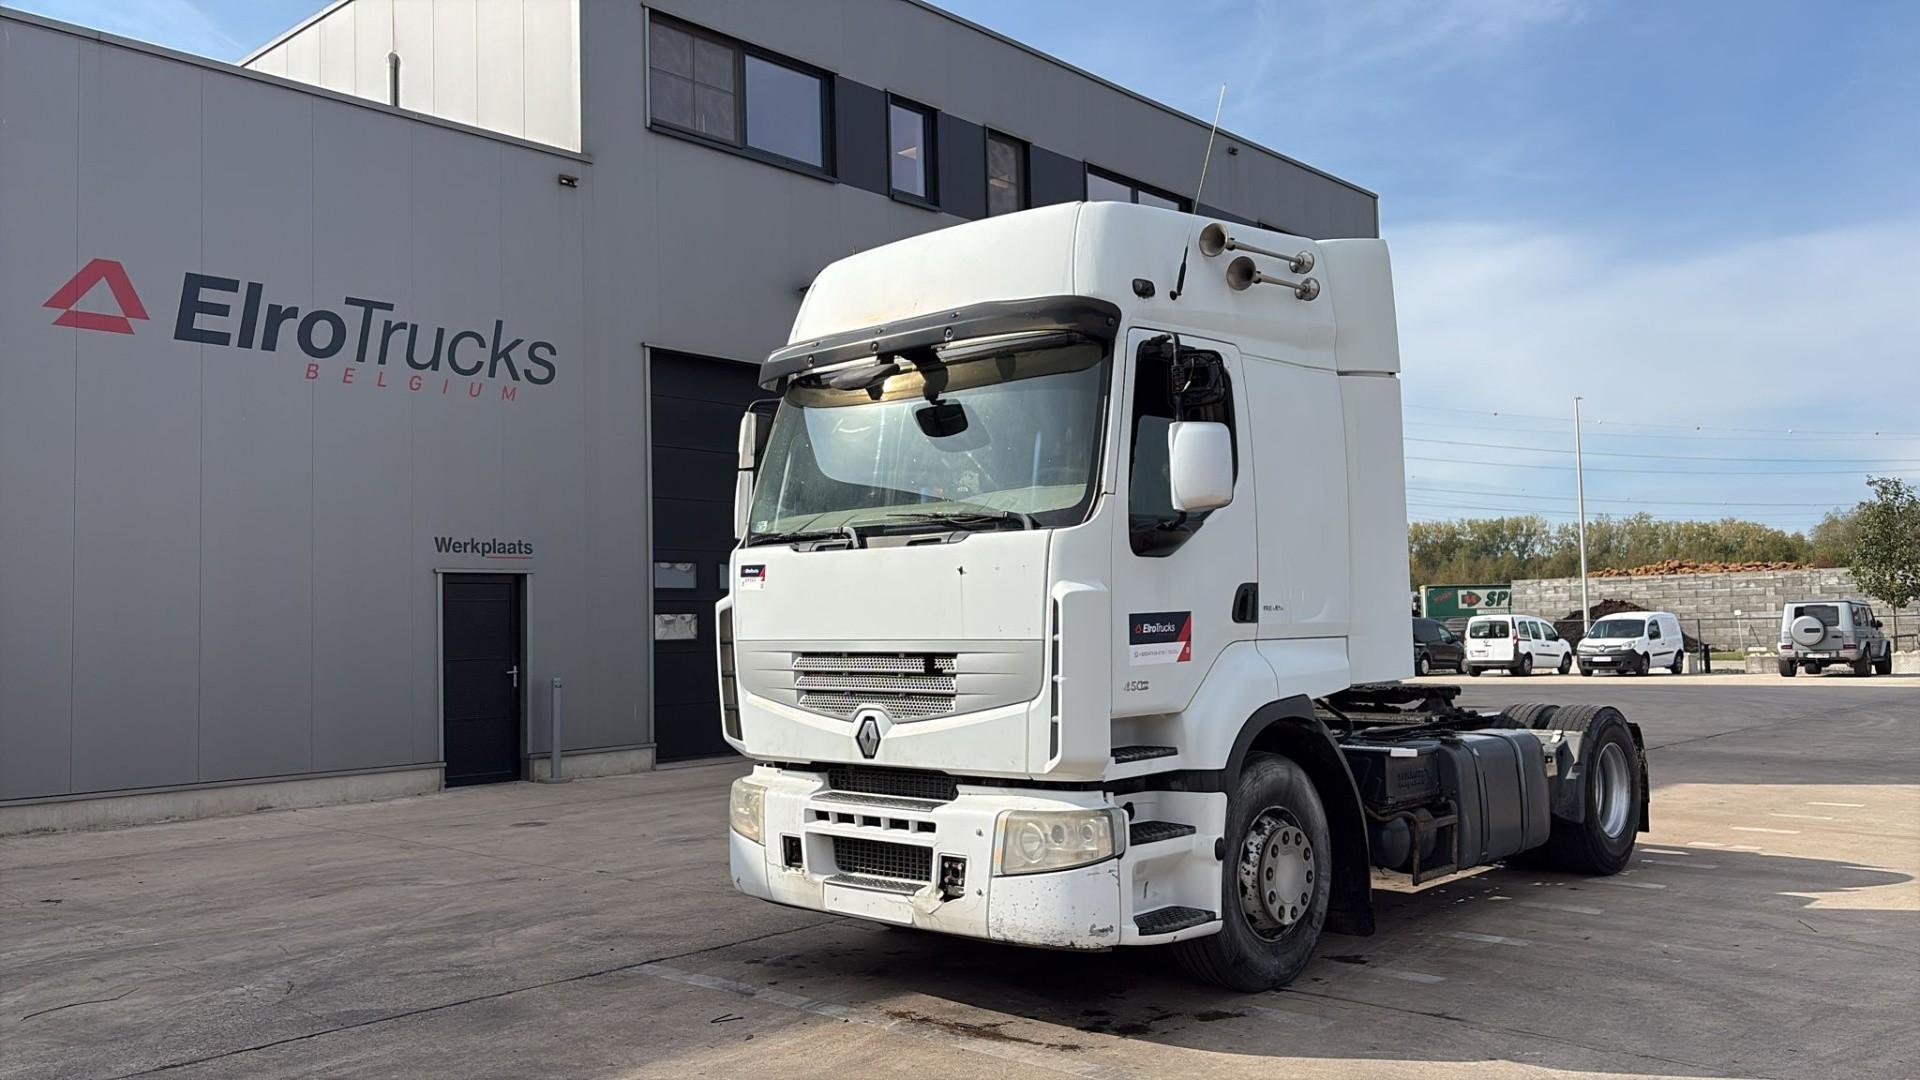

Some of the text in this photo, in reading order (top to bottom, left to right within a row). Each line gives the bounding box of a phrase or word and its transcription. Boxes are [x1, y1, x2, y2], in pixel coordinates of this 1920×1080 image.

[173, 272, 558, 386] ElroTrucks
[305, 363, 517, 401] BELGIUM
[434, 536, 533, 556] Werkplaats
[1142, 622, 1176, 634] ElroTrucks
